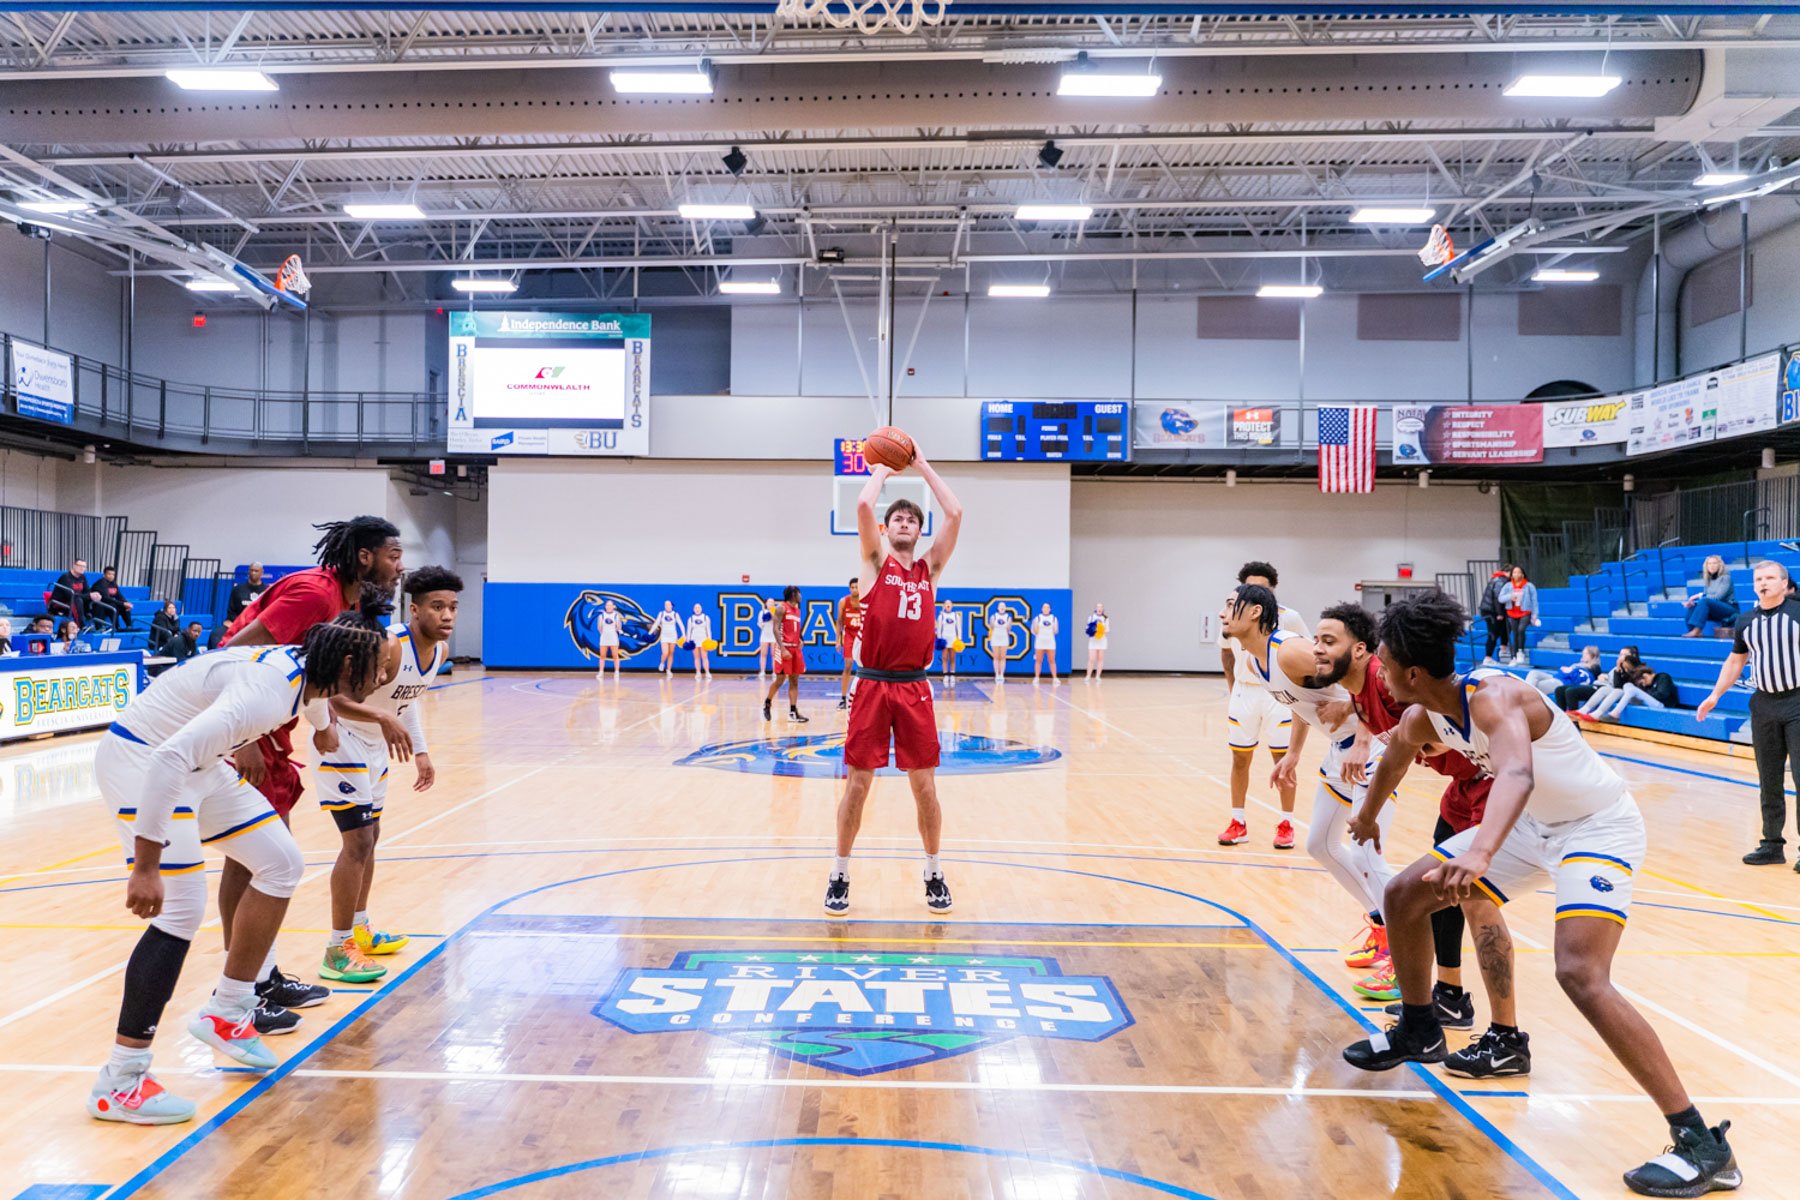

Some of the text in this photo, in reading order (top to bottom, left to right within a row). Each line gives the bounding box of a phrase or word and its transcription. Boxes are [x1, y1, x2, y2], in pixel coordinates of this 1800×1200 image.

[511, 319, 621, 331] Independence Bank
[631, 341, 643, 428] BEARCATS
[988, 403, 1013, 413] HOME
[1095, 404, 1123, 414] GUEST
[1547, 401, 1626, 427] SUBWAY
[1233, 422, 1274, 432] PROTECT
[589, 431, 617, 449] BU
[843, 453, 865, 473] 30
[898, 590, 922, 620] 13
[13, 669, 129, 726] BEARCATS
[729, 966, 1009, 982] RIVER
[616, 977, 1112, 1023] STATES
[669, 1012, 1057, 1032] CONFERENCE
